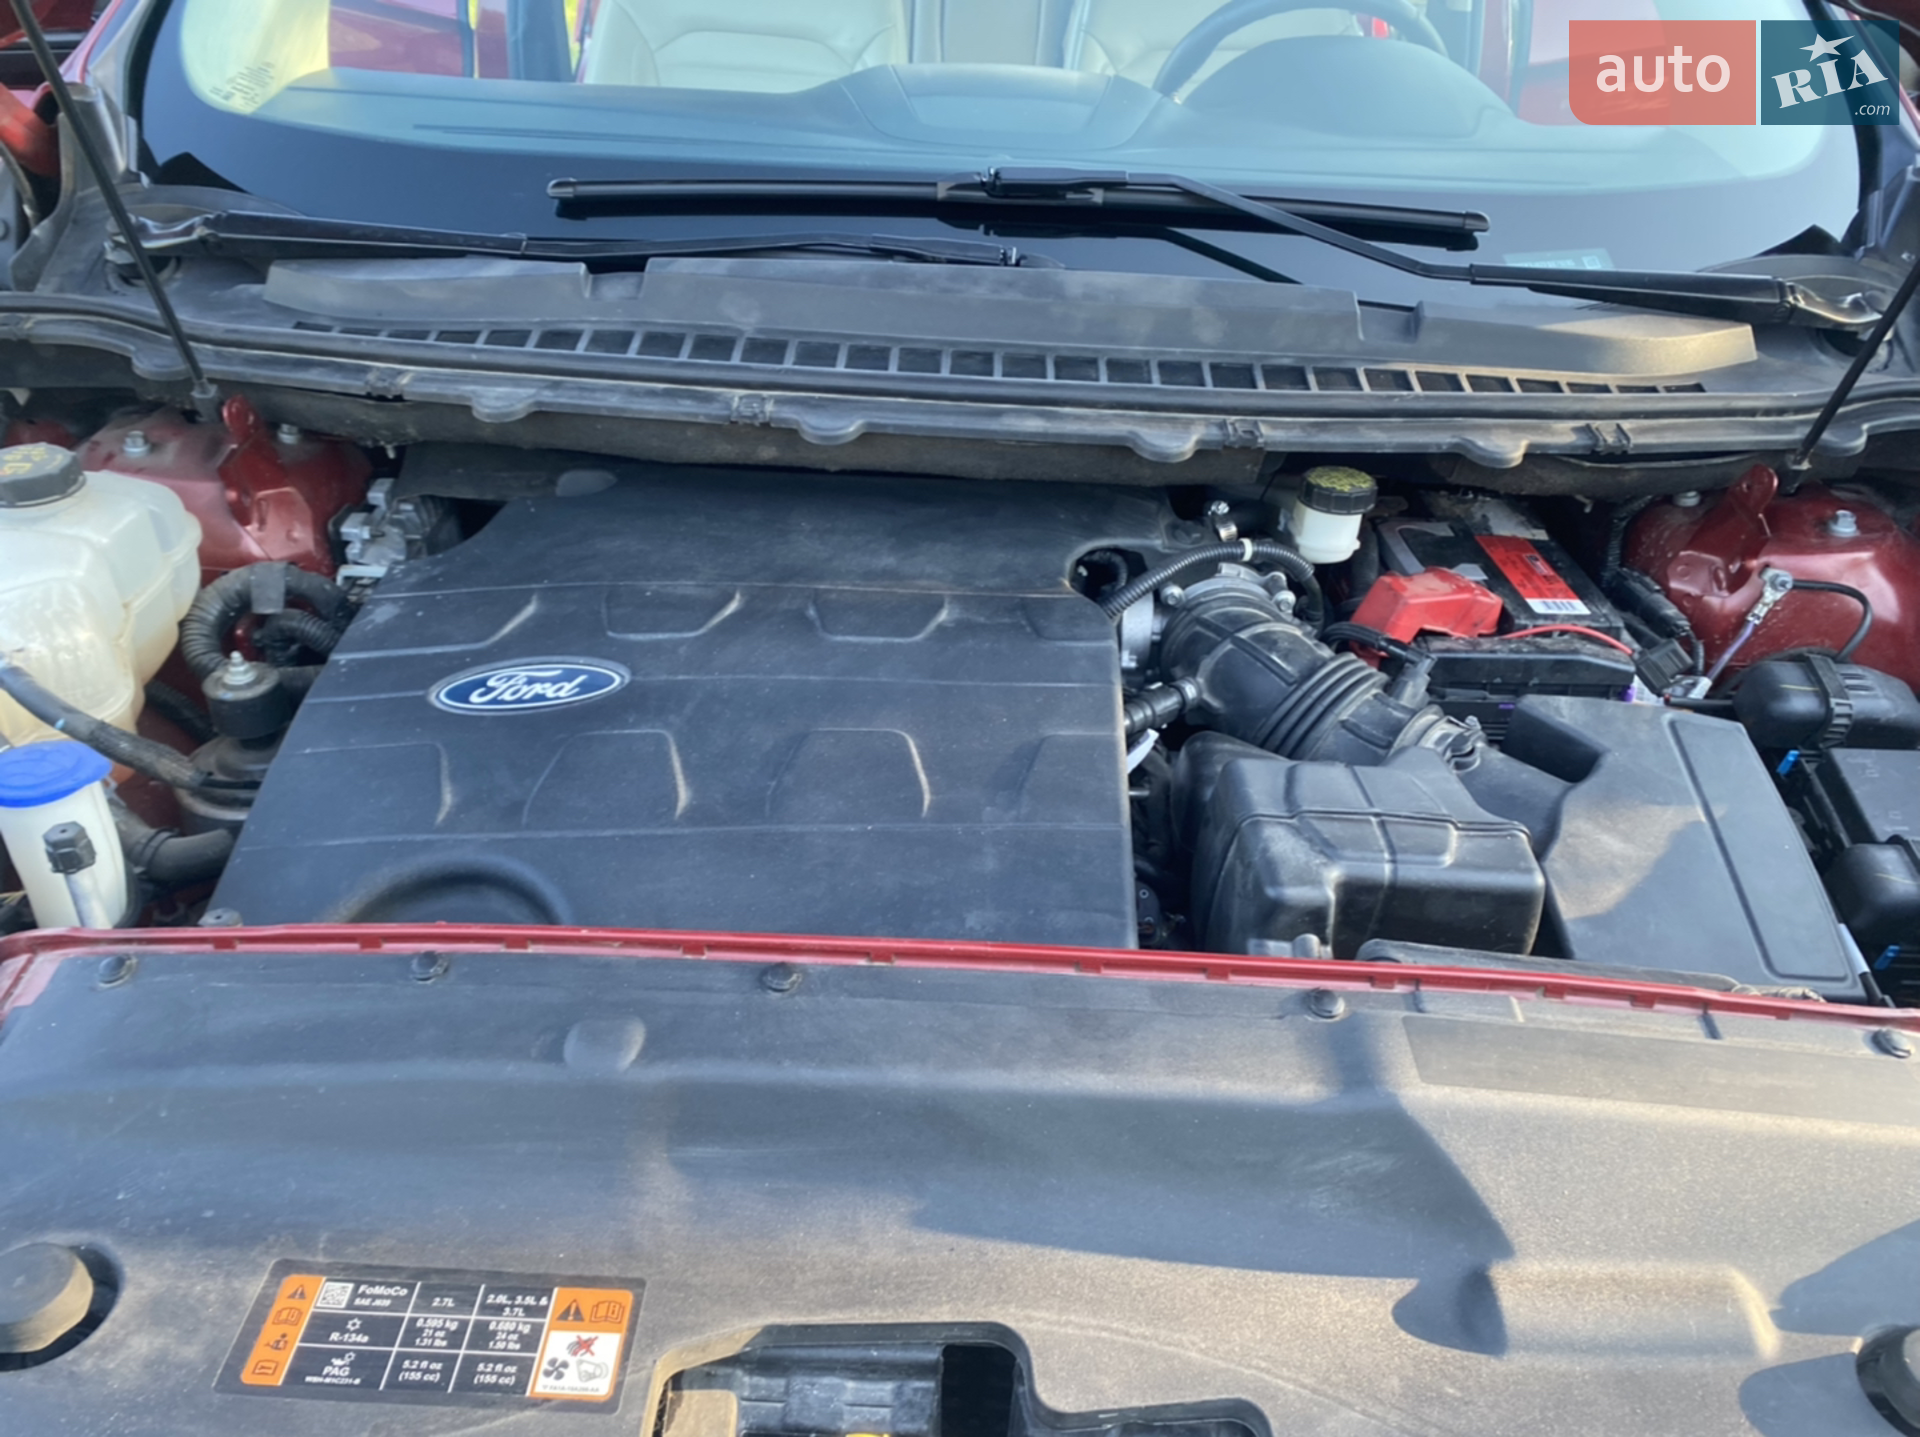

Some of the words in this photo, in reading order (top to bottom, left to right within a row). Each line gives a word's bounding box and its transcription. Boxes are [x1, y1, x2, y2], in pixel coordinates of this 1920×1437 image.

[468, 669, 588, 704] Ford
[357, 1284, 408, 1296] FoMoCo
[431, 1297, 455, 1307] 2.7L
[486, 1294, 512, 1305] 2.0L,
[514, 1295, 537, 1305] 3.5L
[538, 1296, 549, 1306] &
[502, 1307, 526, 1317] 3.7L
[444, 1319, 459, 1331] kg
[516, 1322, 531, 1334] kg
[329, 1332, 370, 1343] R-134a
[422, 1328, 434, 1337] 21
[434, 1330, 446, 1338] oz
[495, 1331, 507, 1340] 24
[507, 1333, 519, 1341] oz
[415, 1337, 432, 1346] 1.31
[433, 1338, 448, 1347] lbs
[507, 1342, 520, 1350] lbs
[322, 1366, 351, 1376] PAG
[402, 1360, 419, 1370] 5.2
[419, 1360, 429, 1370] fl
[429, 1362, 443, 1371] oz
[476, 1362, 493, 1373] 5.2
[494, 1363, 503, 1373] fl
[504, 1365, 518, 1374] oz
[398, 1371, 423, 1382] (155
[422, 1372, 441, 1383] cc)
[474, 1374, 498, 1385] (155
[498, 1375, 516, 1386] cc)
